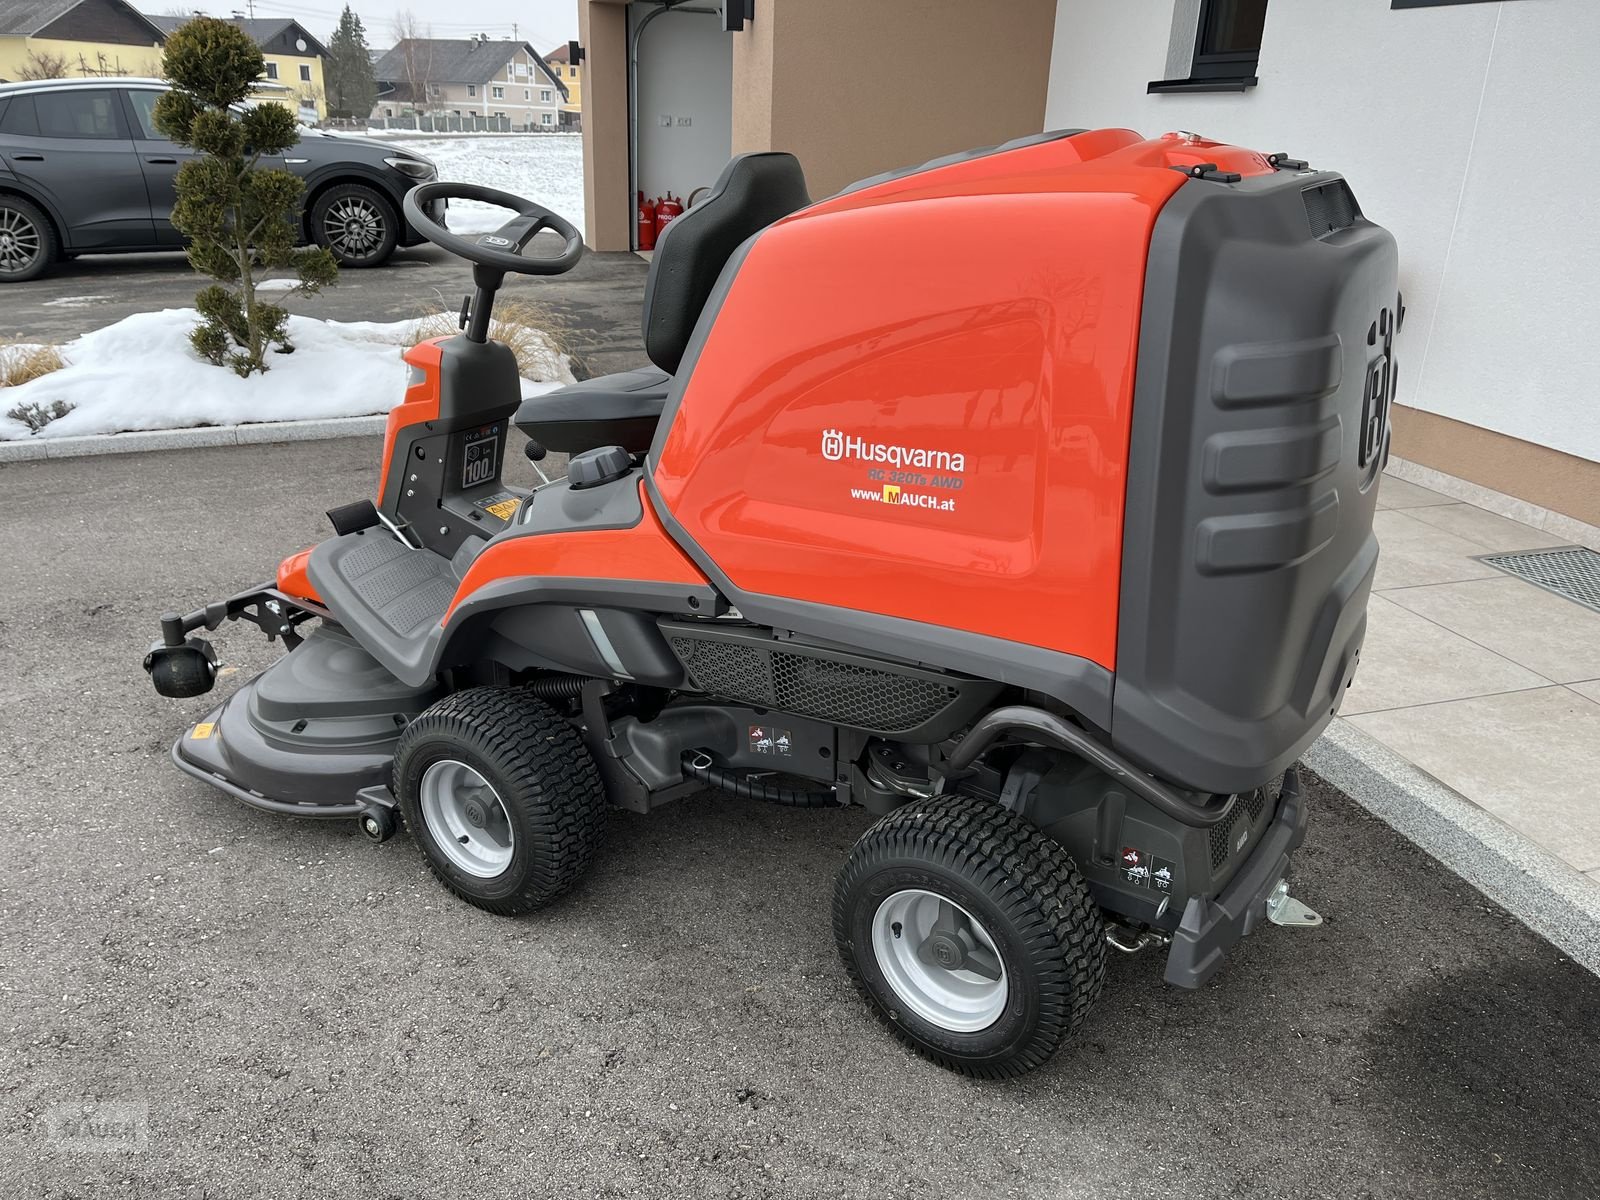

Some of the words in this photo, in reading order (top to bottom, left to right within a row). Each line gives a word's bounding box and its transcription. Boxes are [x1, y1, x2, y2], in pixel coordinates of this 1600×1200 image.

[845, 435, 965, 472] Husqvarna
[467, 458, 489, 482] 100
[867, 468, 884, 480] RC
[930, 475, 964, 490] AWD
[851, 487, 955, 512] www.MAUCH.at
